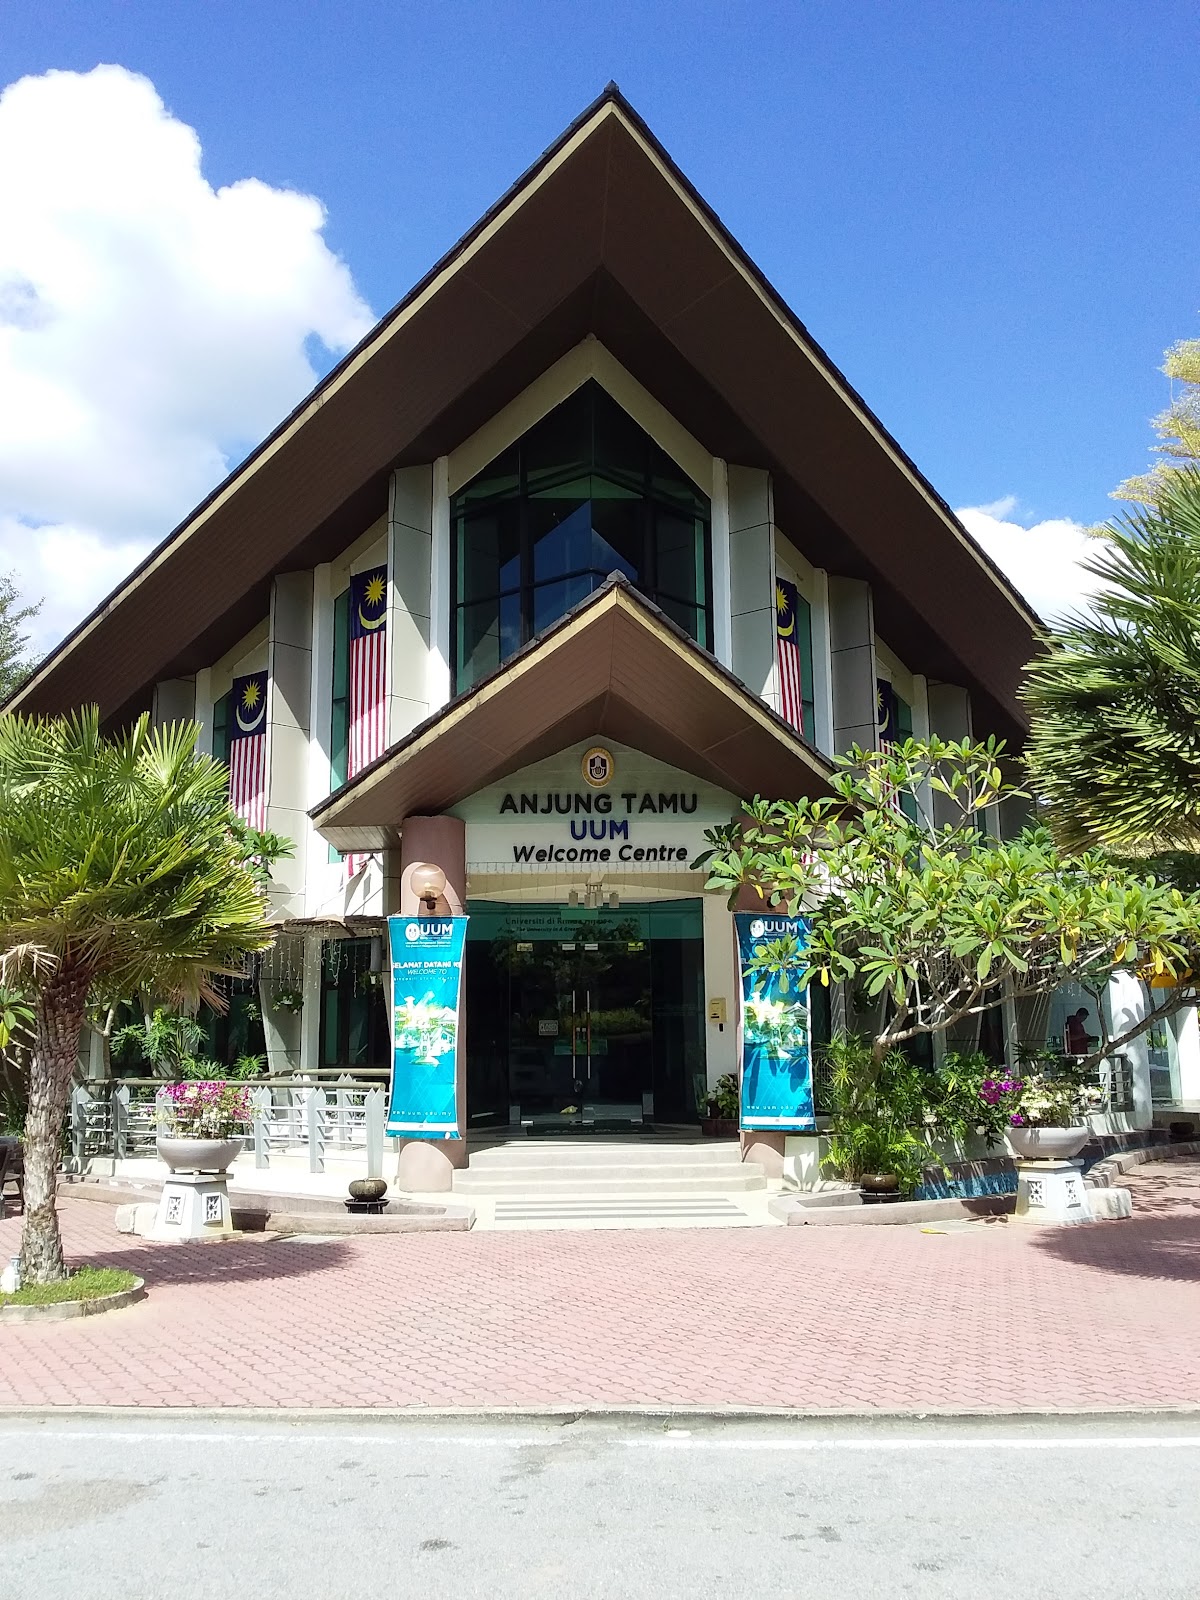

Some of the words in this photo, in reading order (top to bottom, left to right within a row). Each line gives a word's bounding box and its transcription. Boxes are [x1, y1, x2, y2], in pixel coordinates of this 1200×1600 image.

[500, 794, 612, 814] ANJUNG
[621, 794, 698, 814] TAMU
[570, 819, 629, 840] UUM
[513, 845, 611, 863] Welcome
[618, 844, 688, 861] Centre
[420, 923, 453, 935] UUM
[764, 920, 798, 932] UUM
